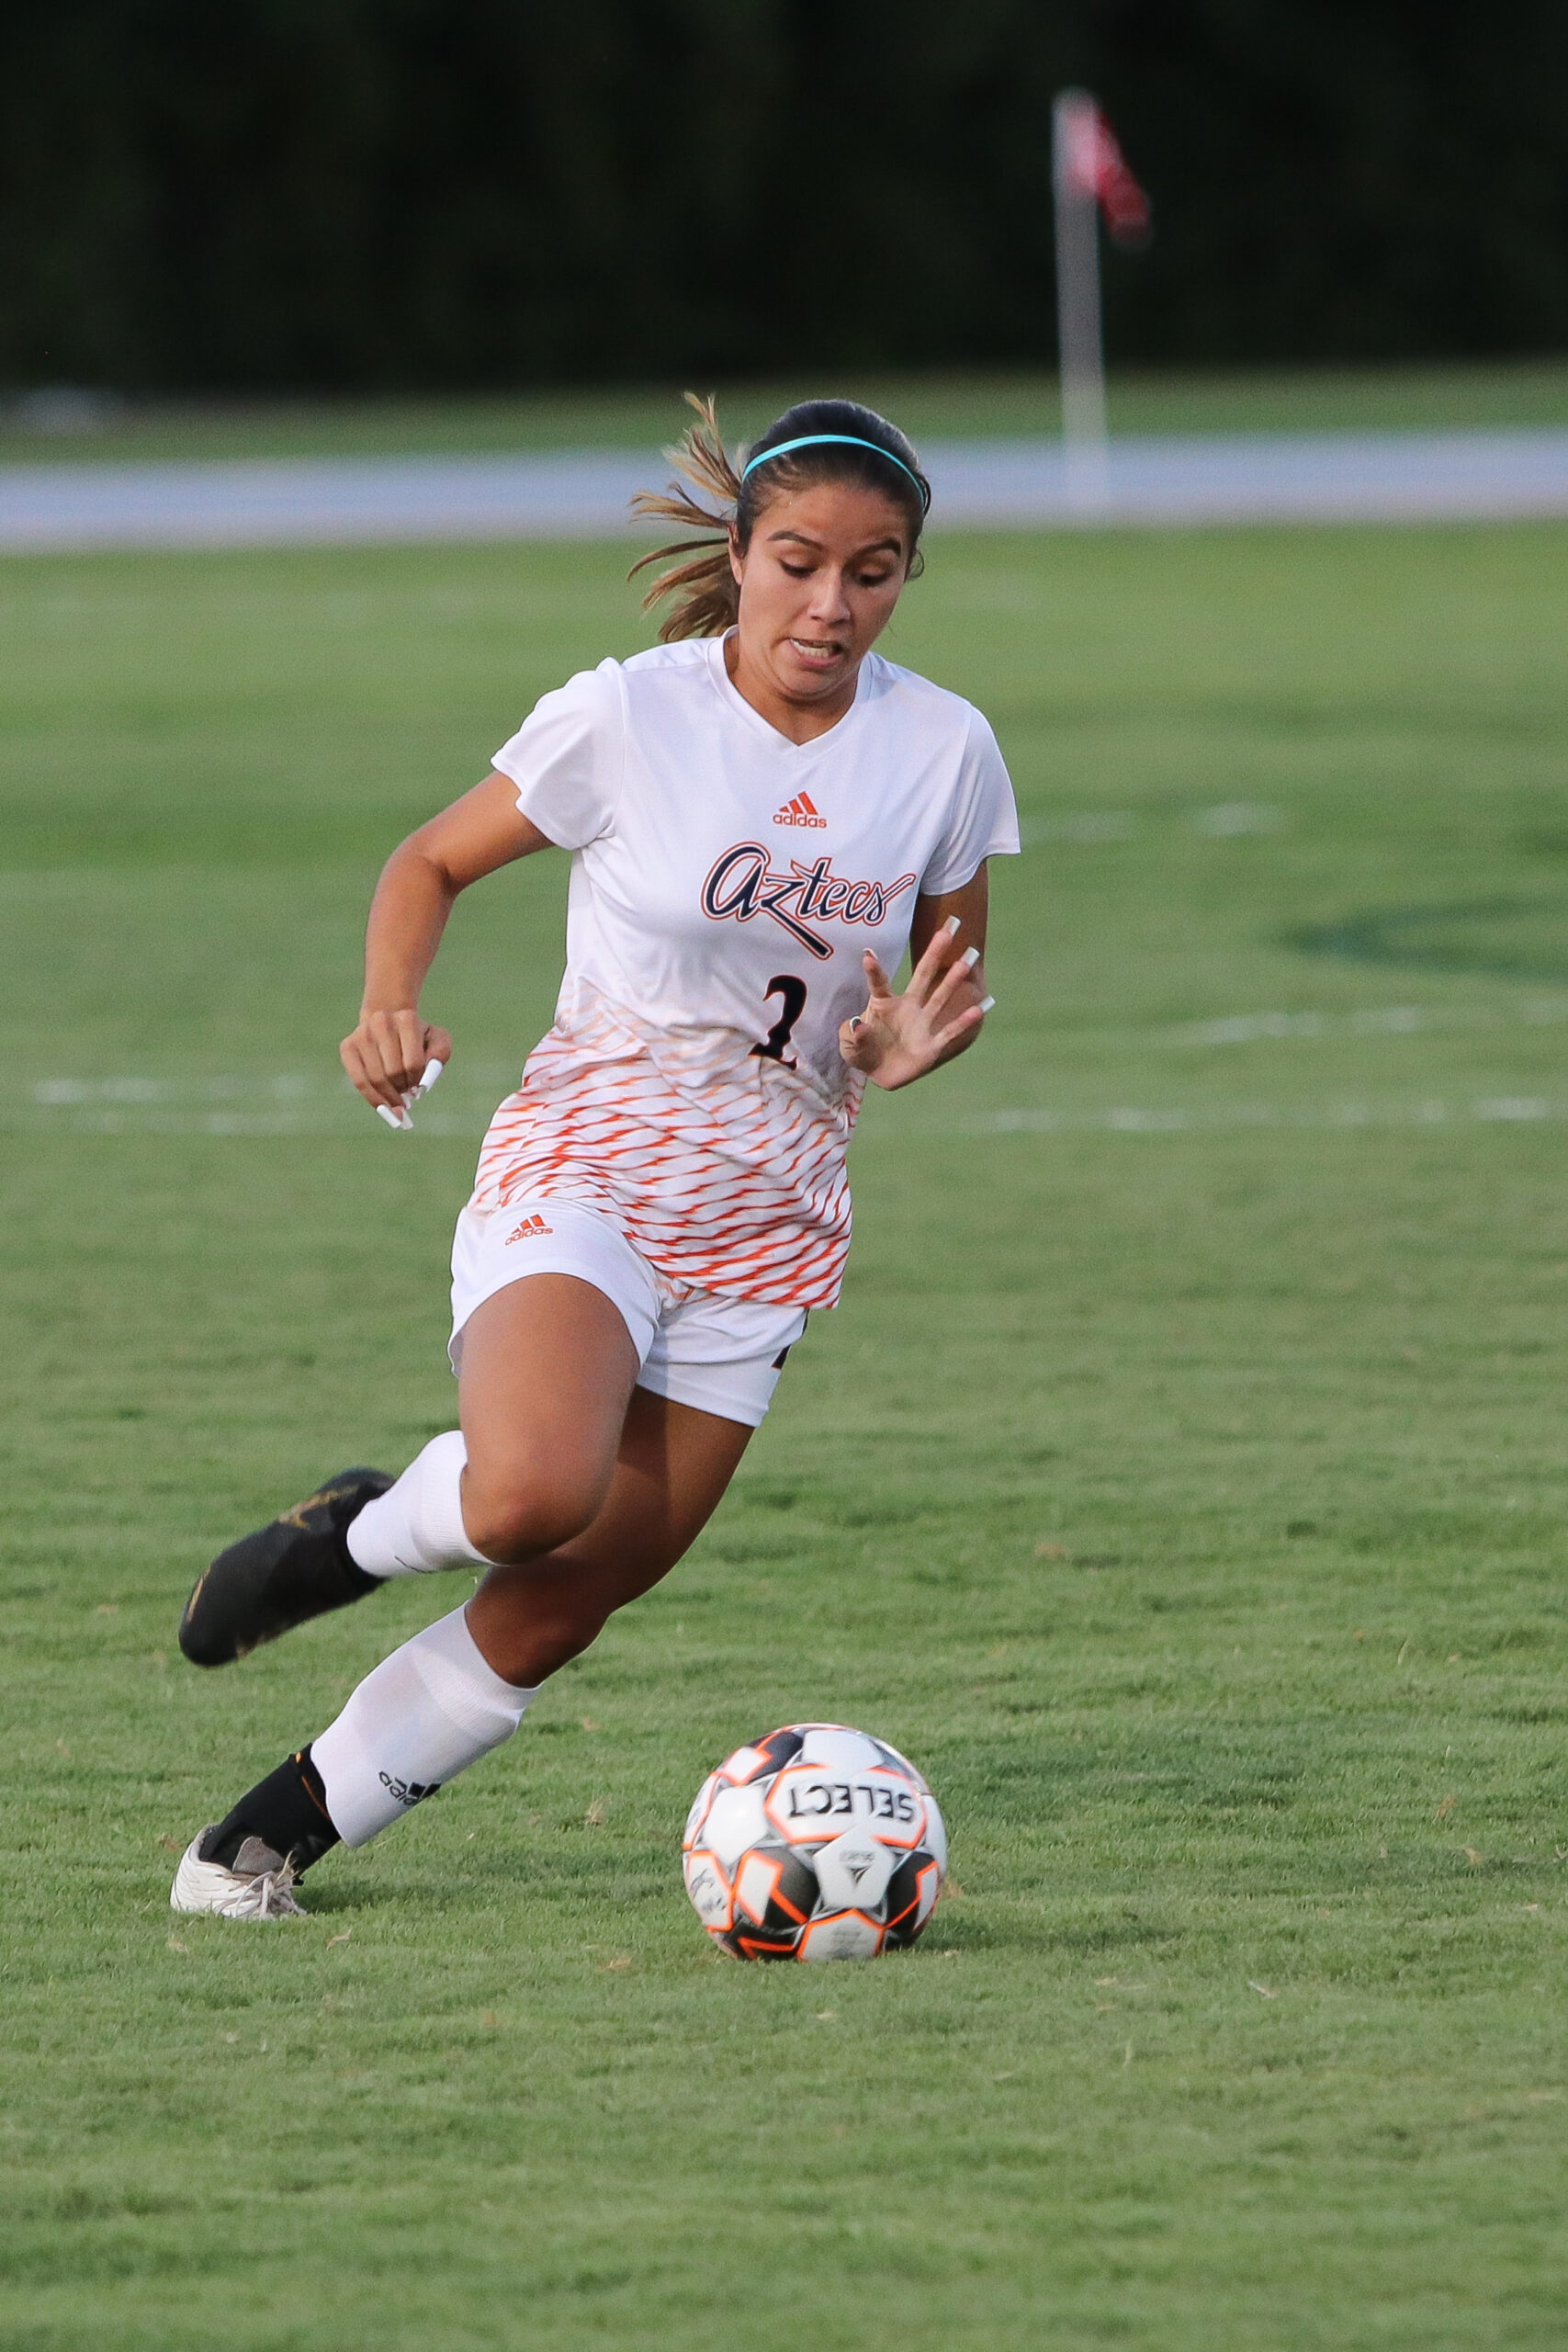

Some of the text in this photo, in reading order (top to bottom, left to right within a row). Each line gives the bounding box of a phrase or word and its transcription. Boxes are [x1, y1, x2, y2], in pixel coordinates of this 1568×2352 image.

[773, 812, 828, 829] adidas
[701, 841, 916, 960] Aztecs
[504, 1227, 554, 1246] adidas
[787, 1783, 915, 1822] SELECT
